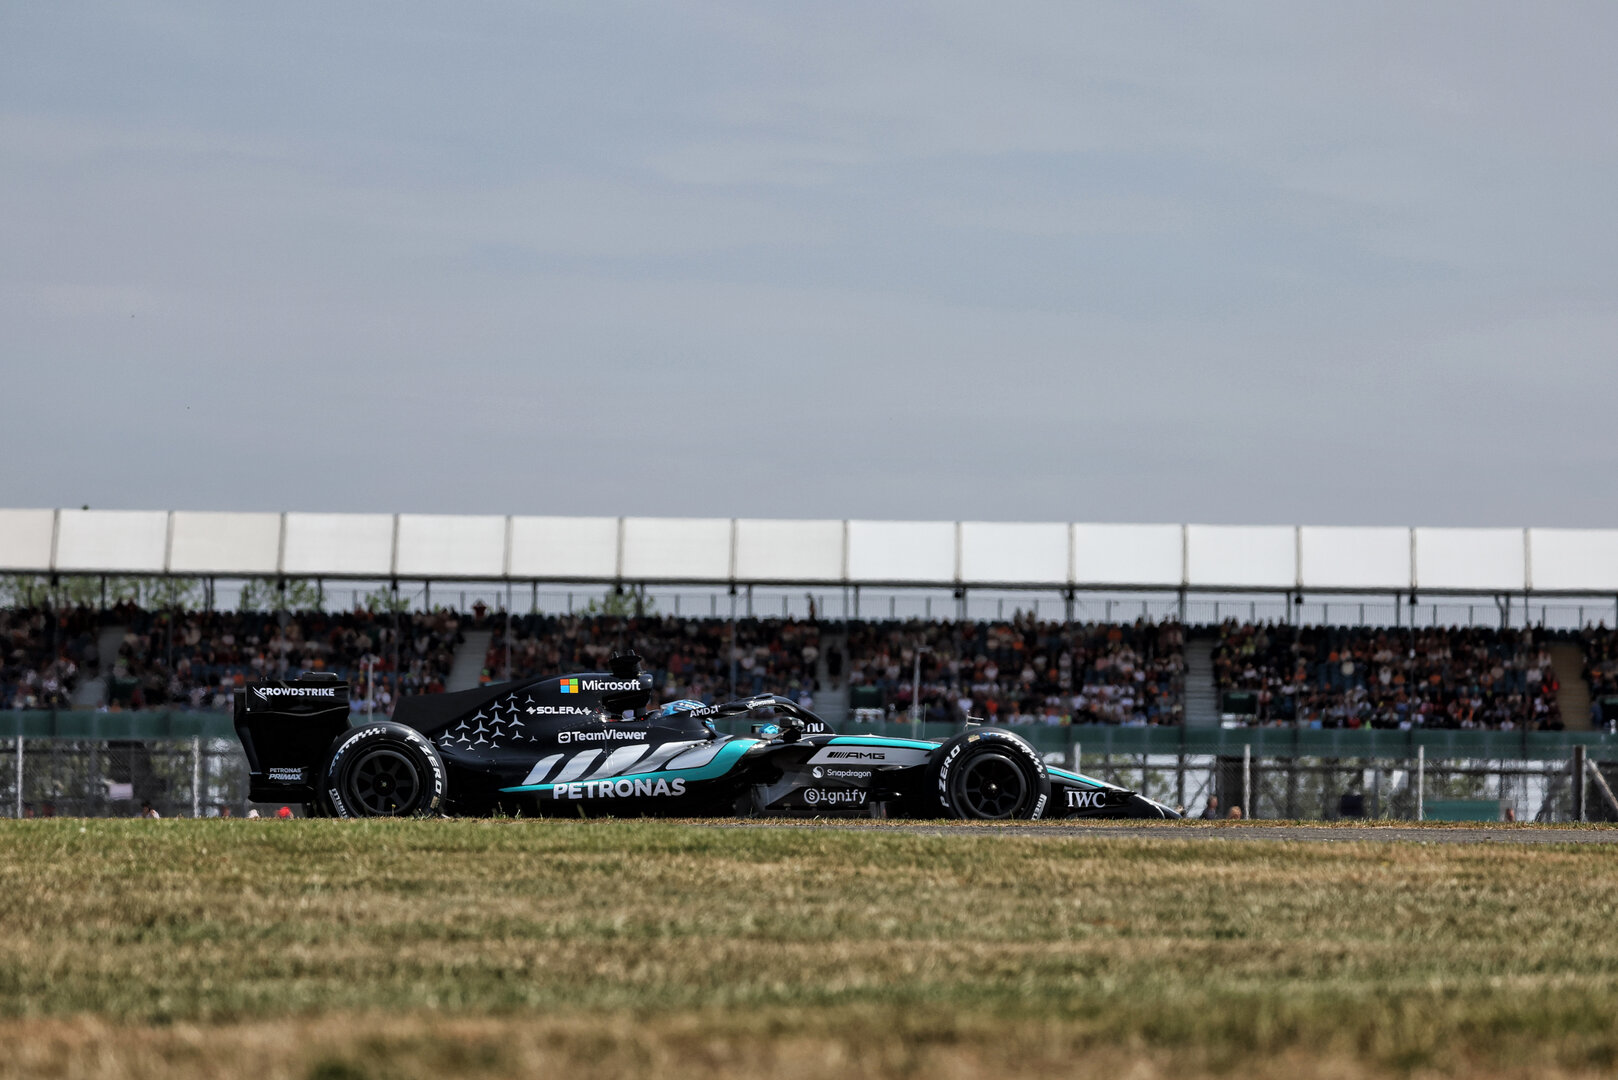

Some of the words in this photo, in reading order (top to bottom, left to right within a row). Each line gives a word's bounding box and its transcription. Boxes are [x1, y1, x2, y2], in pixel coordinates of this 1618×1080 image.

[582, 679, 641, 691] Microsoft
[259, 687, 335, 697] CROWDSTRIKE
[536, 706, 583, 715] SOLERA
[690, 707, 711, 718] AMD
[806, 722, 825, 733] nu
[572, 729, 647, 741] TeamViewer
[845, 751, 886, 760] AMG
[419, 745, 442, 794] ZERO
[826, 769, 872, 778] Snapdragon
[938, 744, 961, 792] ZERO
[553, 777, 686, 799] PETRONAS
[1067, 791, 1106, 808] IWC
[1031, 794, 1047, 820] PIRELL
